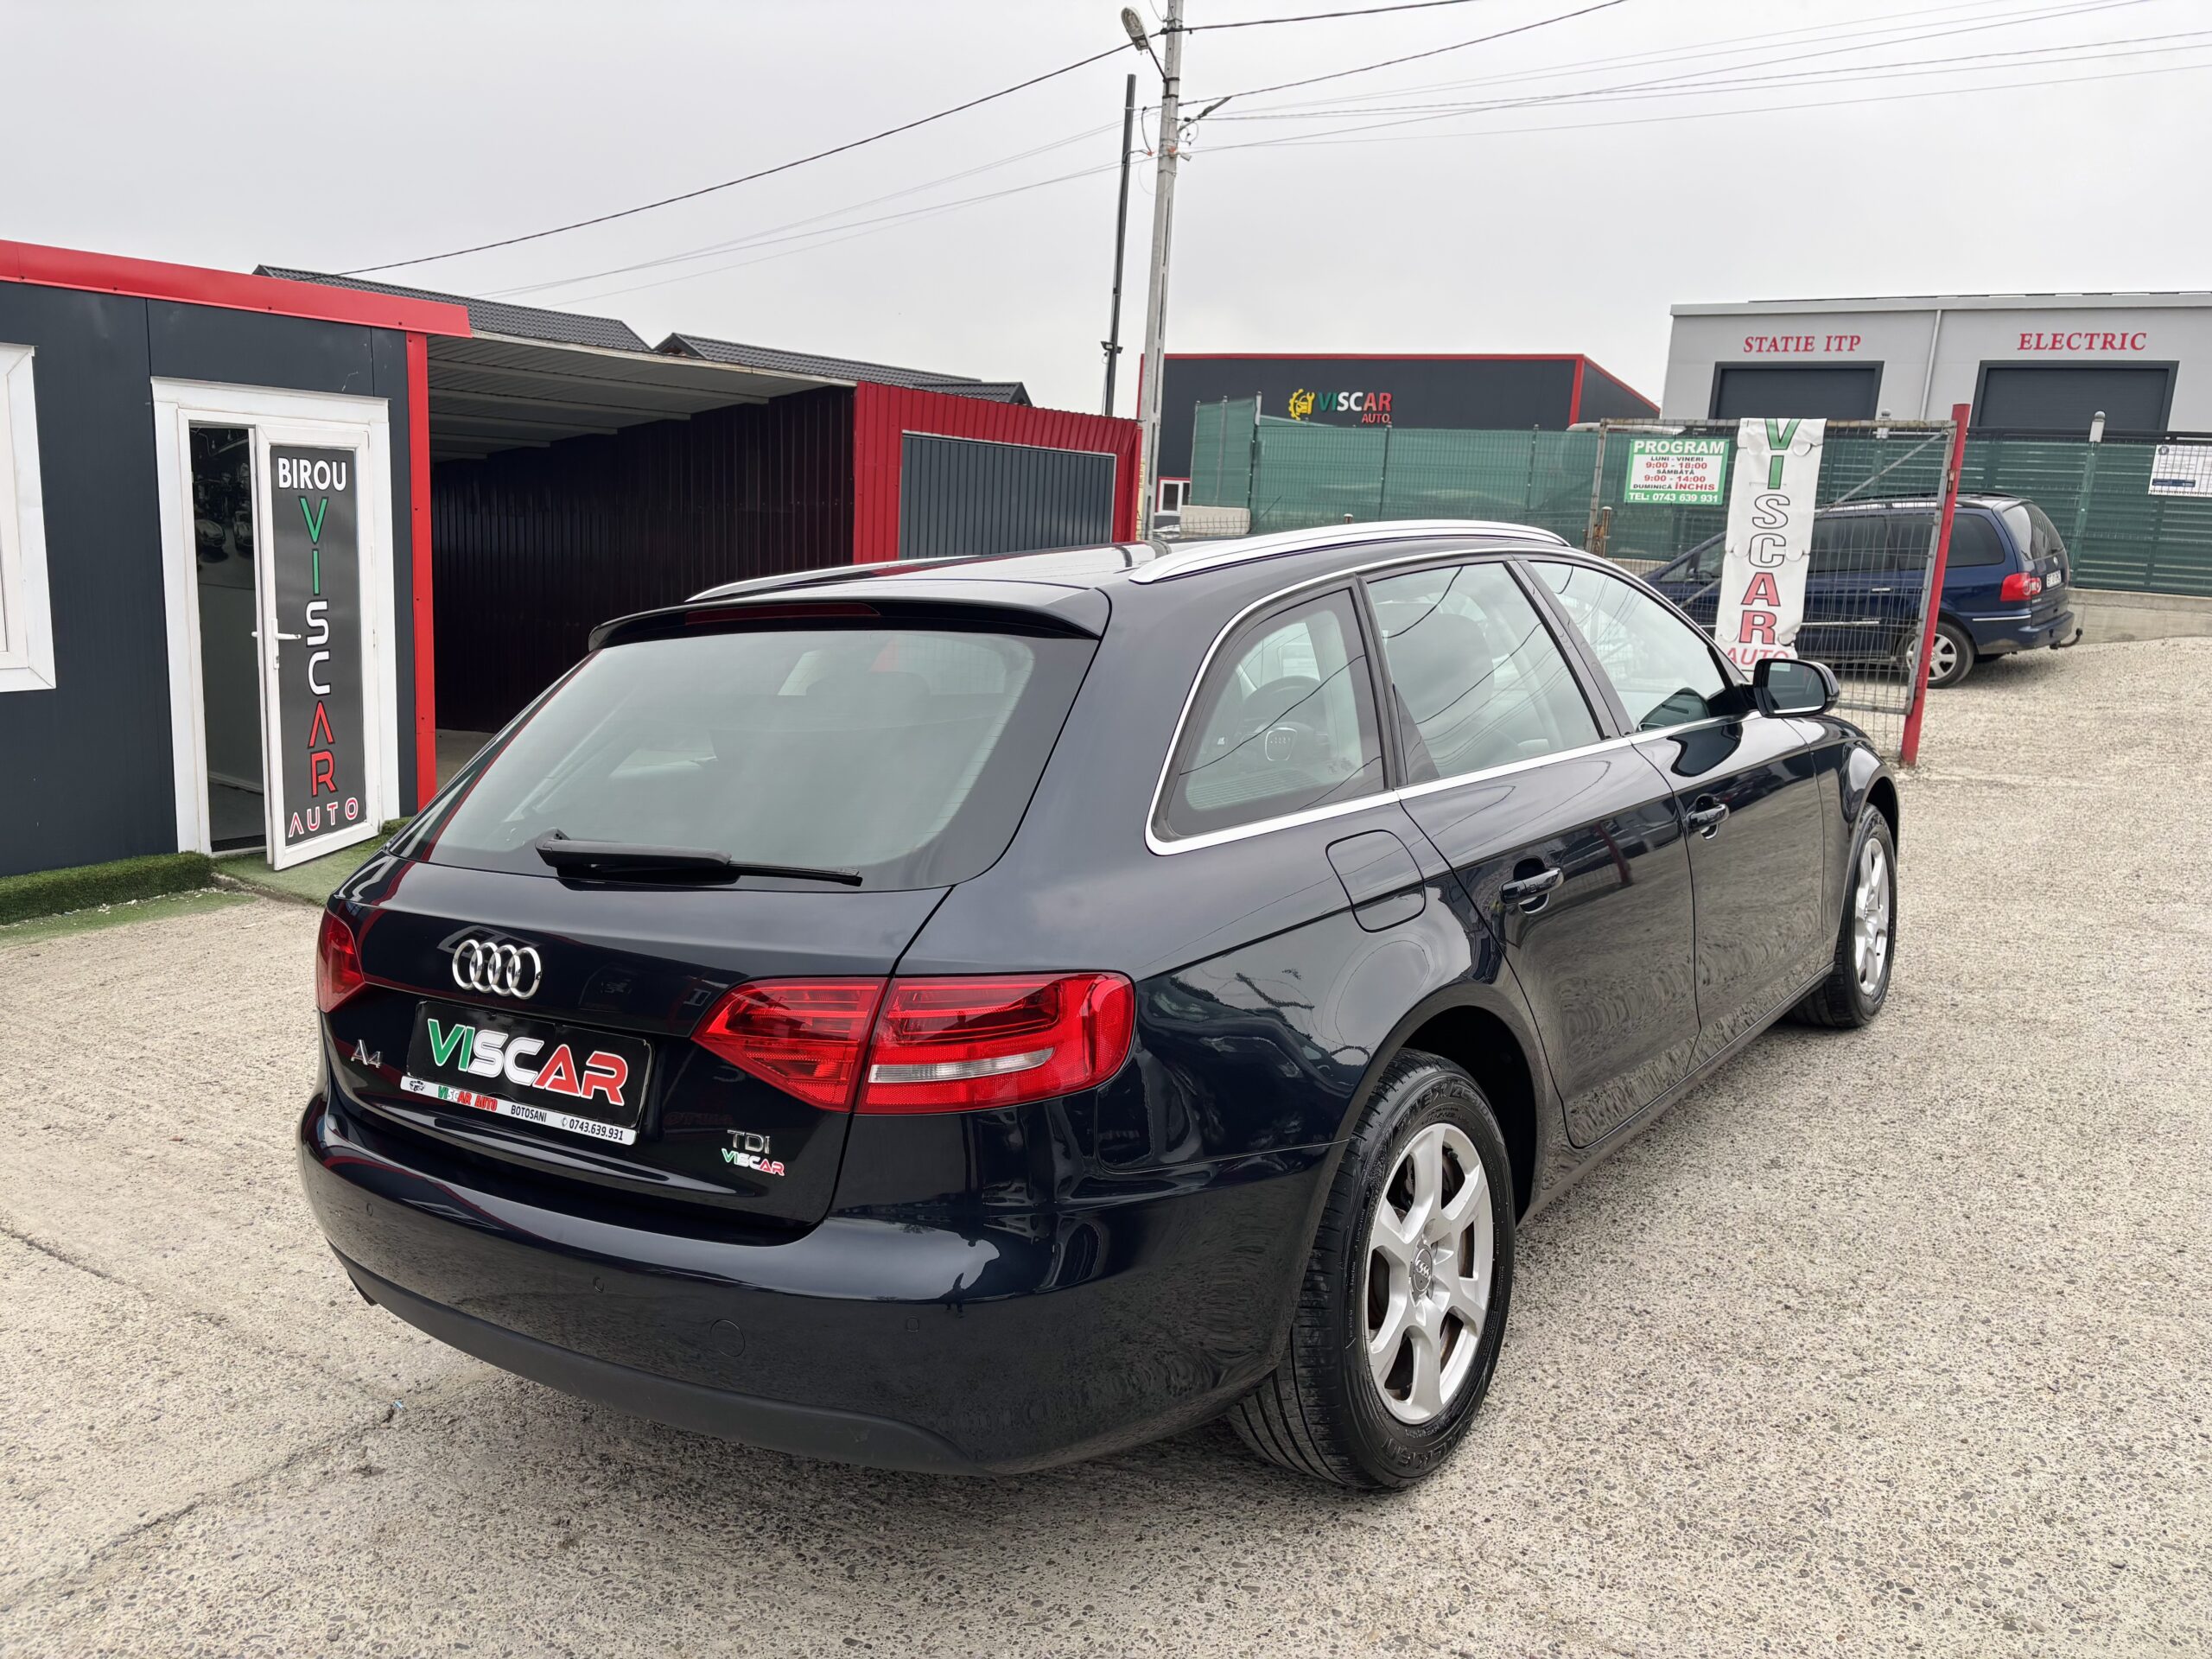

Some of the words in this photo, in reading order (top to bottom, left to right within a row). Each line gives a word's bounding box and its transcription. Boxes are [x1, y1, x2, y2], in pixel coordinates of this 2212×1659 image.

[1743, 335, 1815, 353] STATIE
[1824, 334, 1862, 353] ITP
[2017, 331, 2148, 351] ELECTRIC
[1319, 391, 1393, 412] VISCAR
[1361, 413, 1391, 423] AUTO
[1633, 441, 1726, 454] PROGRAM
[277, 457, 346, 491] BIROU
[1738, 418, 1802, 645] VISCAR
[298, 495, 338, 797] VISCAR
[288, 797, 359, 838] AUTO
[350, 1039, 381, 1068] A4
[427, 1018, 629, 1107] VISCAR
[438, 1085, 472, 1105] VISCAR
[474, 1096, 498, 1112] AUTO
[511, 1104, 547, 1122] BOTOSANI
[569, 1118, 624, 1141] 0743.639.931
[728, 1129, 771, 1154] TDI
[721, 1147, 785, 1176] VISCAR
